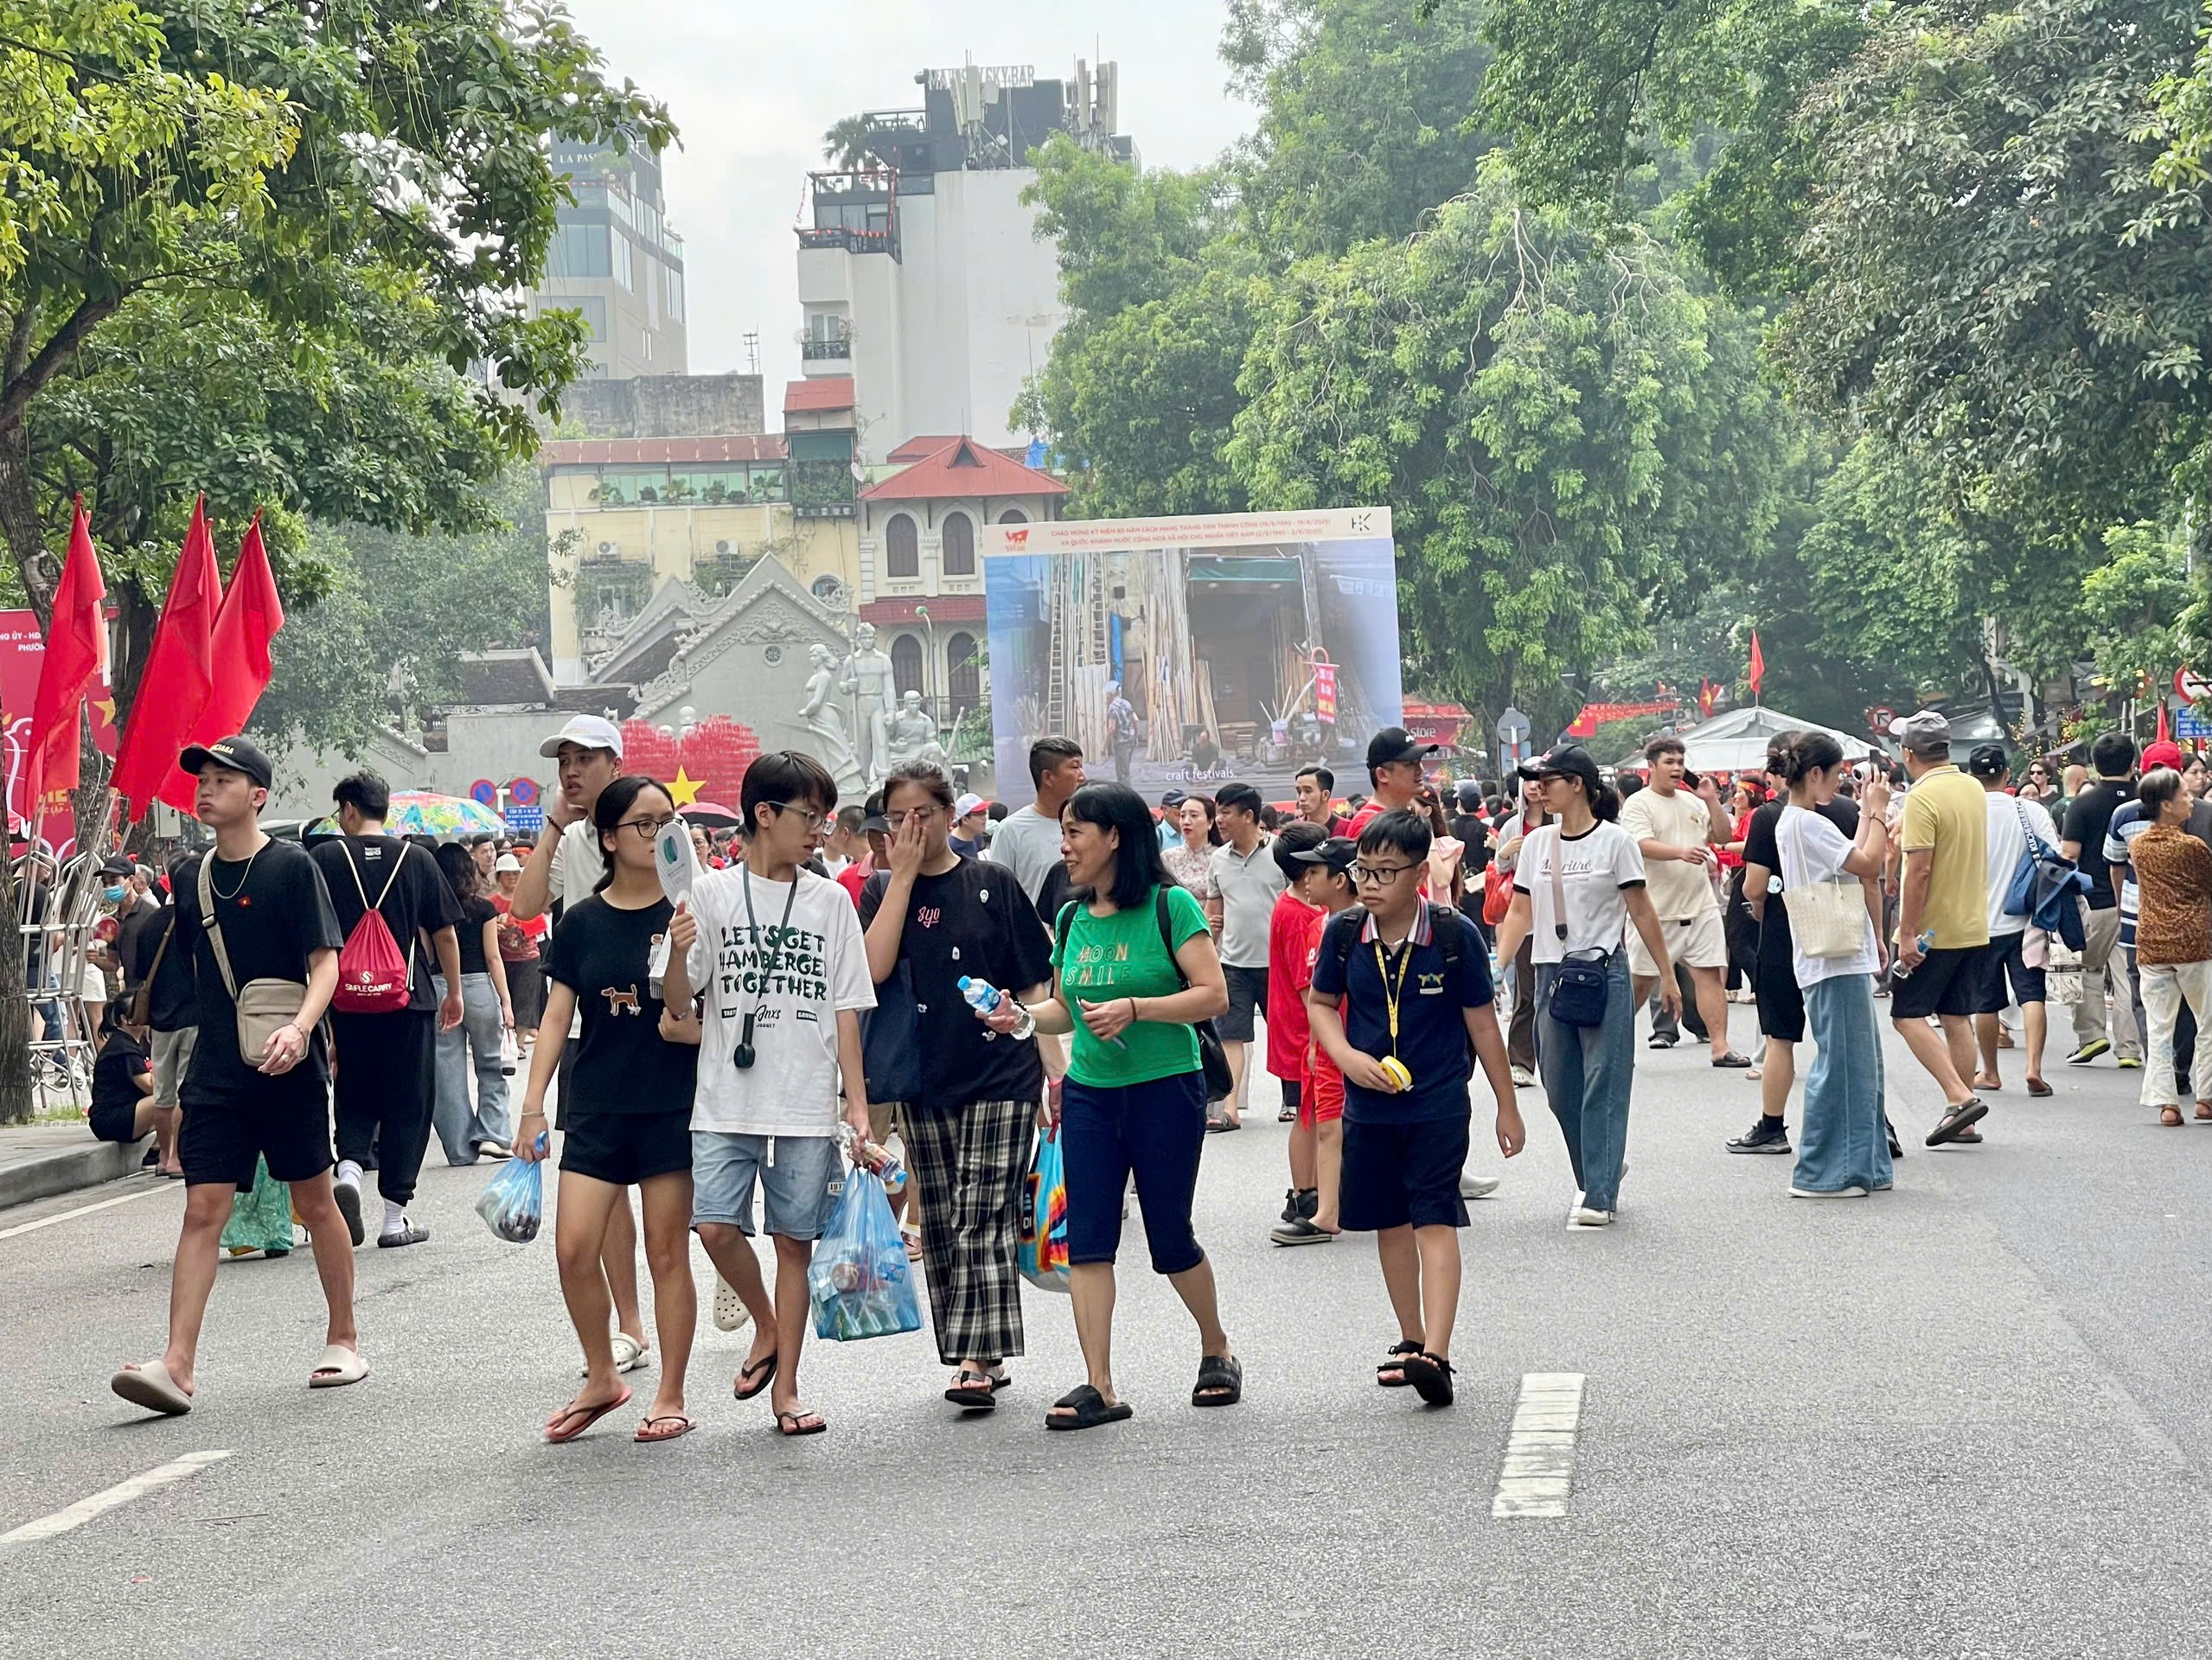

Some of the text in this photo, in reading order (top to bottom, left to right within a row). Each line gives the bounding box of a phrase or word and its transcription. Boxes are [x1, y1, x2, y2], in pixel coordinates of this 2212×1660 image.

[559, 154, 572, 163] LA
[18, 642, 46, 651] PHƯỜN
[1410, 726, 1436, 737] store
[1166, 766, 1237, 781] craft festivals.
[1541, 859, 1591, 872] Mrithé
[781, 927, 826, 953] GET
[1065, 965, 1133, 986] SMILE
[720, 972, 827, 1000] TOGETHER
